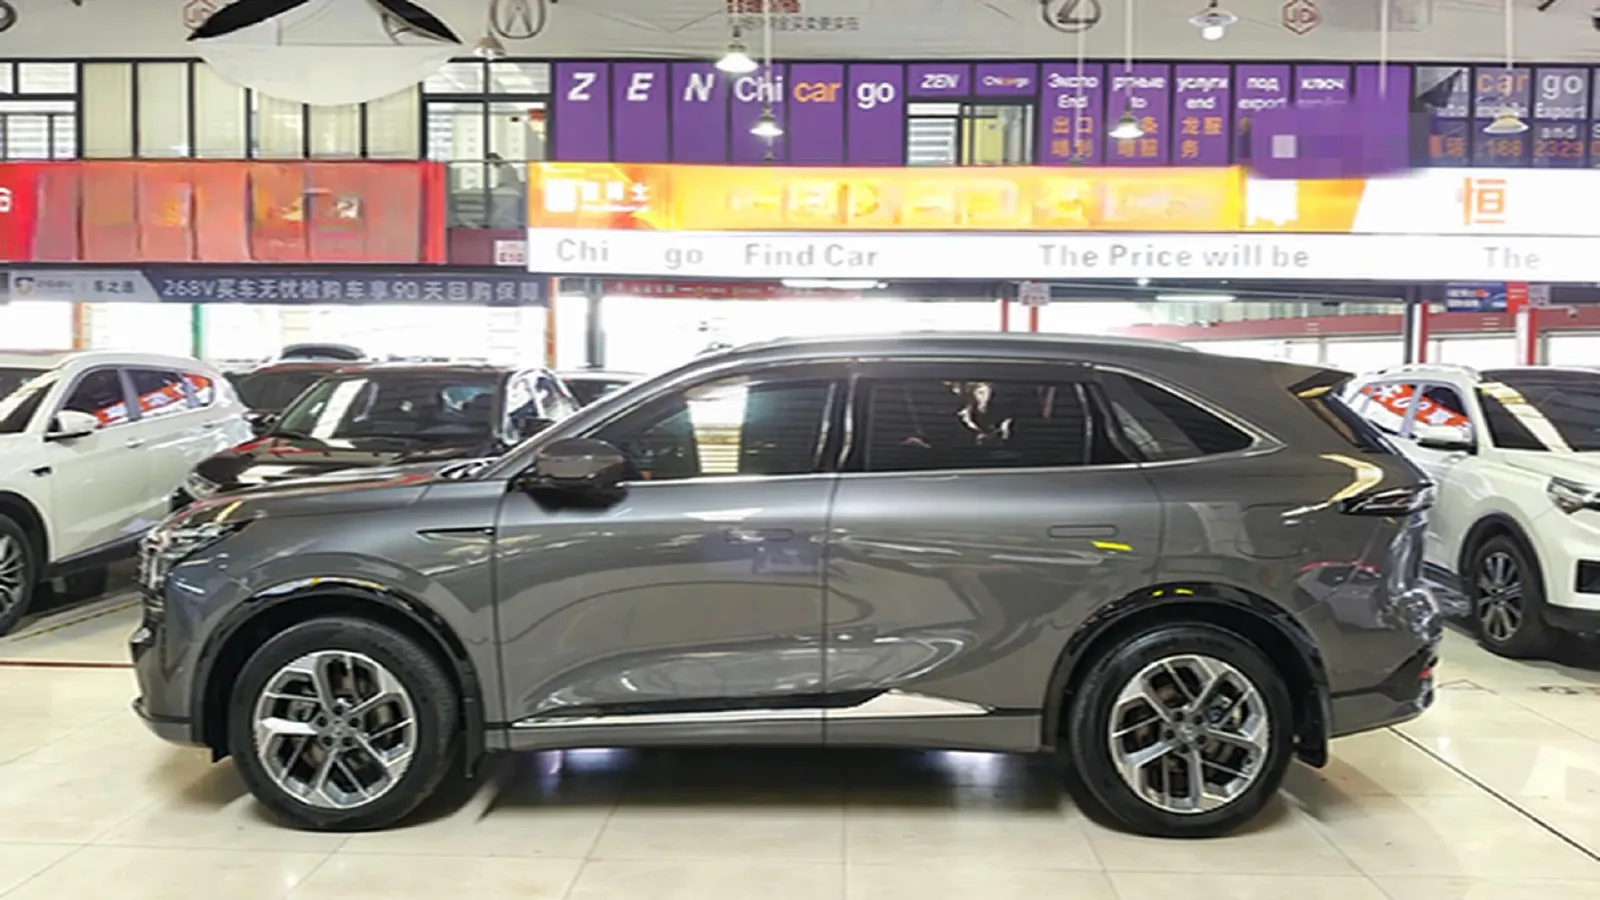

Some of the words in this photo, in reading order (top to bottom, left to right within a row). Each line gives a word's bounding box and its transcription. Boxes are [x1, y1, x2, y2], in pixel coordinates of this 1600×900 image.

[734, 76, 783, 102] Chi
[793, 80, 841, 102] car
[857, 82, 895, 109] go
[921, 74, 959, 88] ZEN
[1477, 72, 1529, 94] car
[1542, 75, 1583, 100] go
[556, 238, 609, 262] Chi
[664, 247, 703, 270] go
[744, 243, 814, 267] Find
[824, 244, 878, 267] Car
[1039, 244, 1098, 267] The
[1108, 244, 1192, 267] Price
[1203, 244, 1262, 267] will
[1272, 245, 1309, 268] be
[1483, 246, 1541, 269] The
